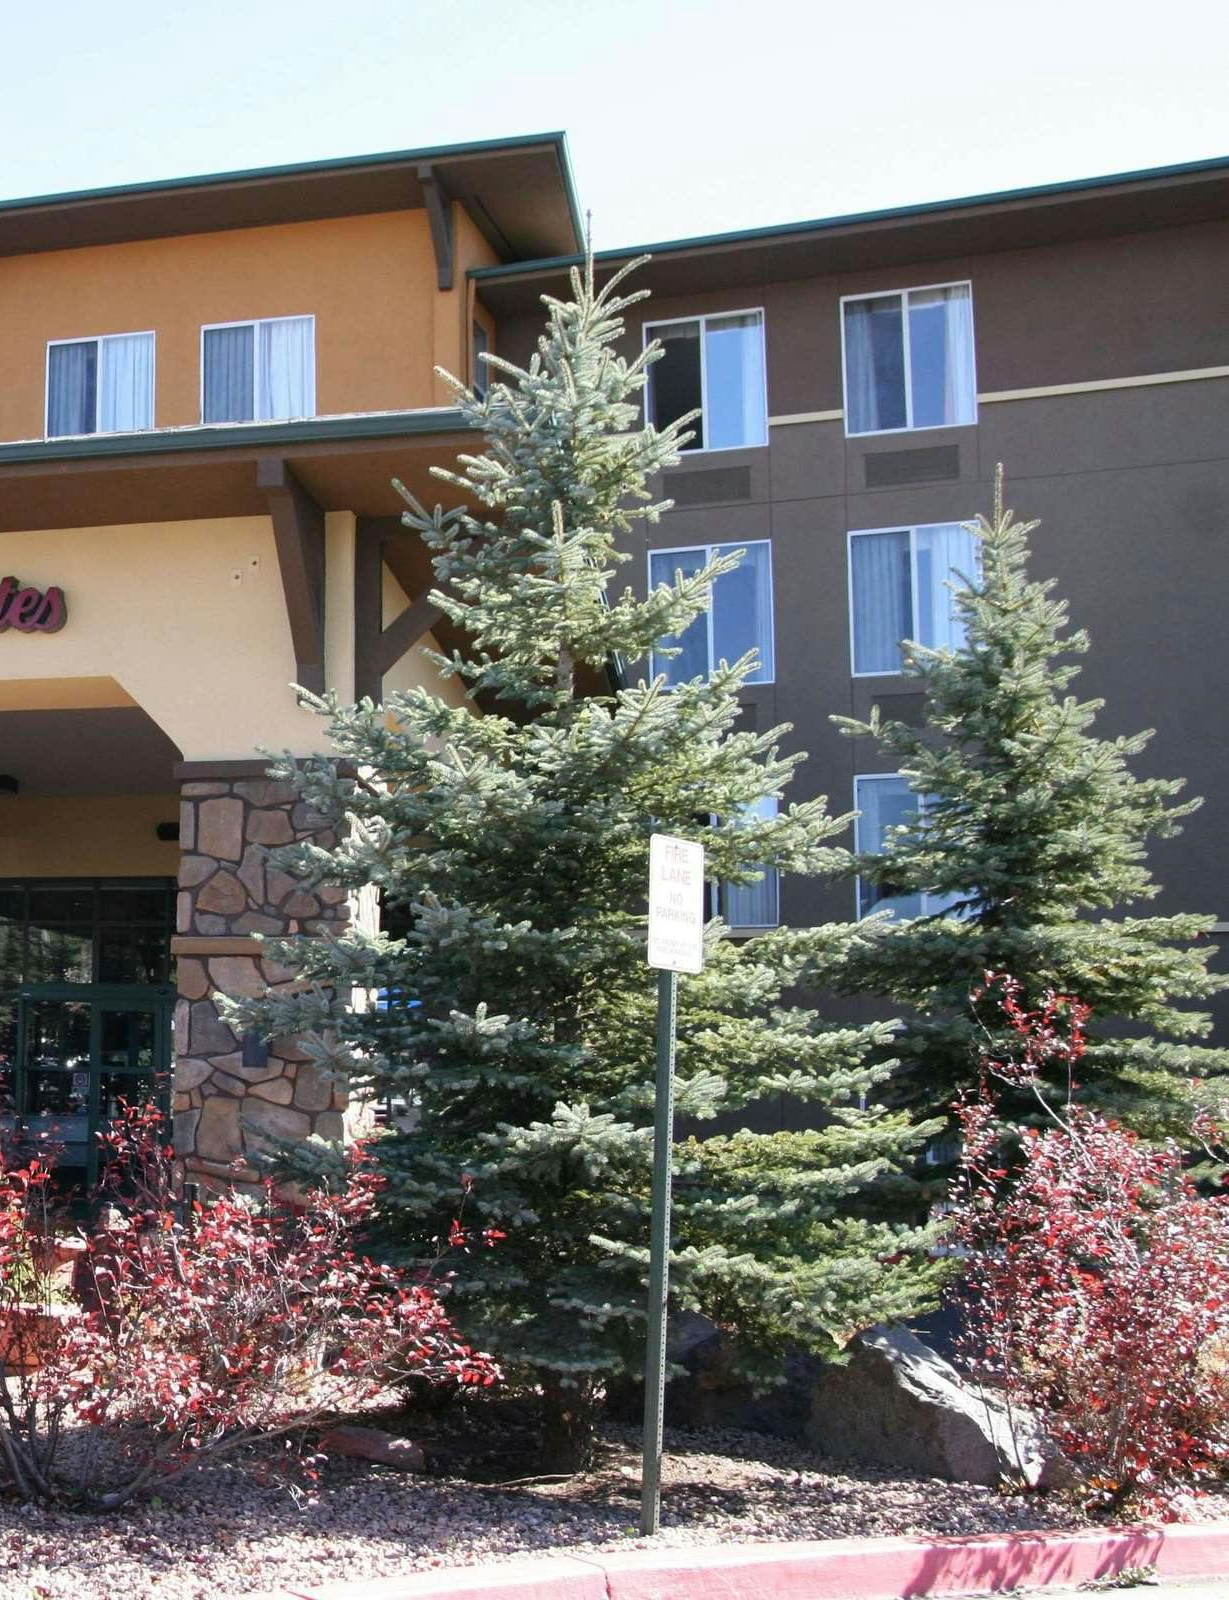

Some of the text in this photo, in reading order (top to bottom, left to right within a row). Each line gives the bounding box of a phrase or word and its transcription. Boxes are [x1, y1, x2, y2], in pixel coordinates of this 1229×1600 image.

[665, 845, 689, 864] FIRE
[661, 865, 692, 886] LANE
[669, 890, 683, 906] NO
[656, 905, 696, 924] PARKING
